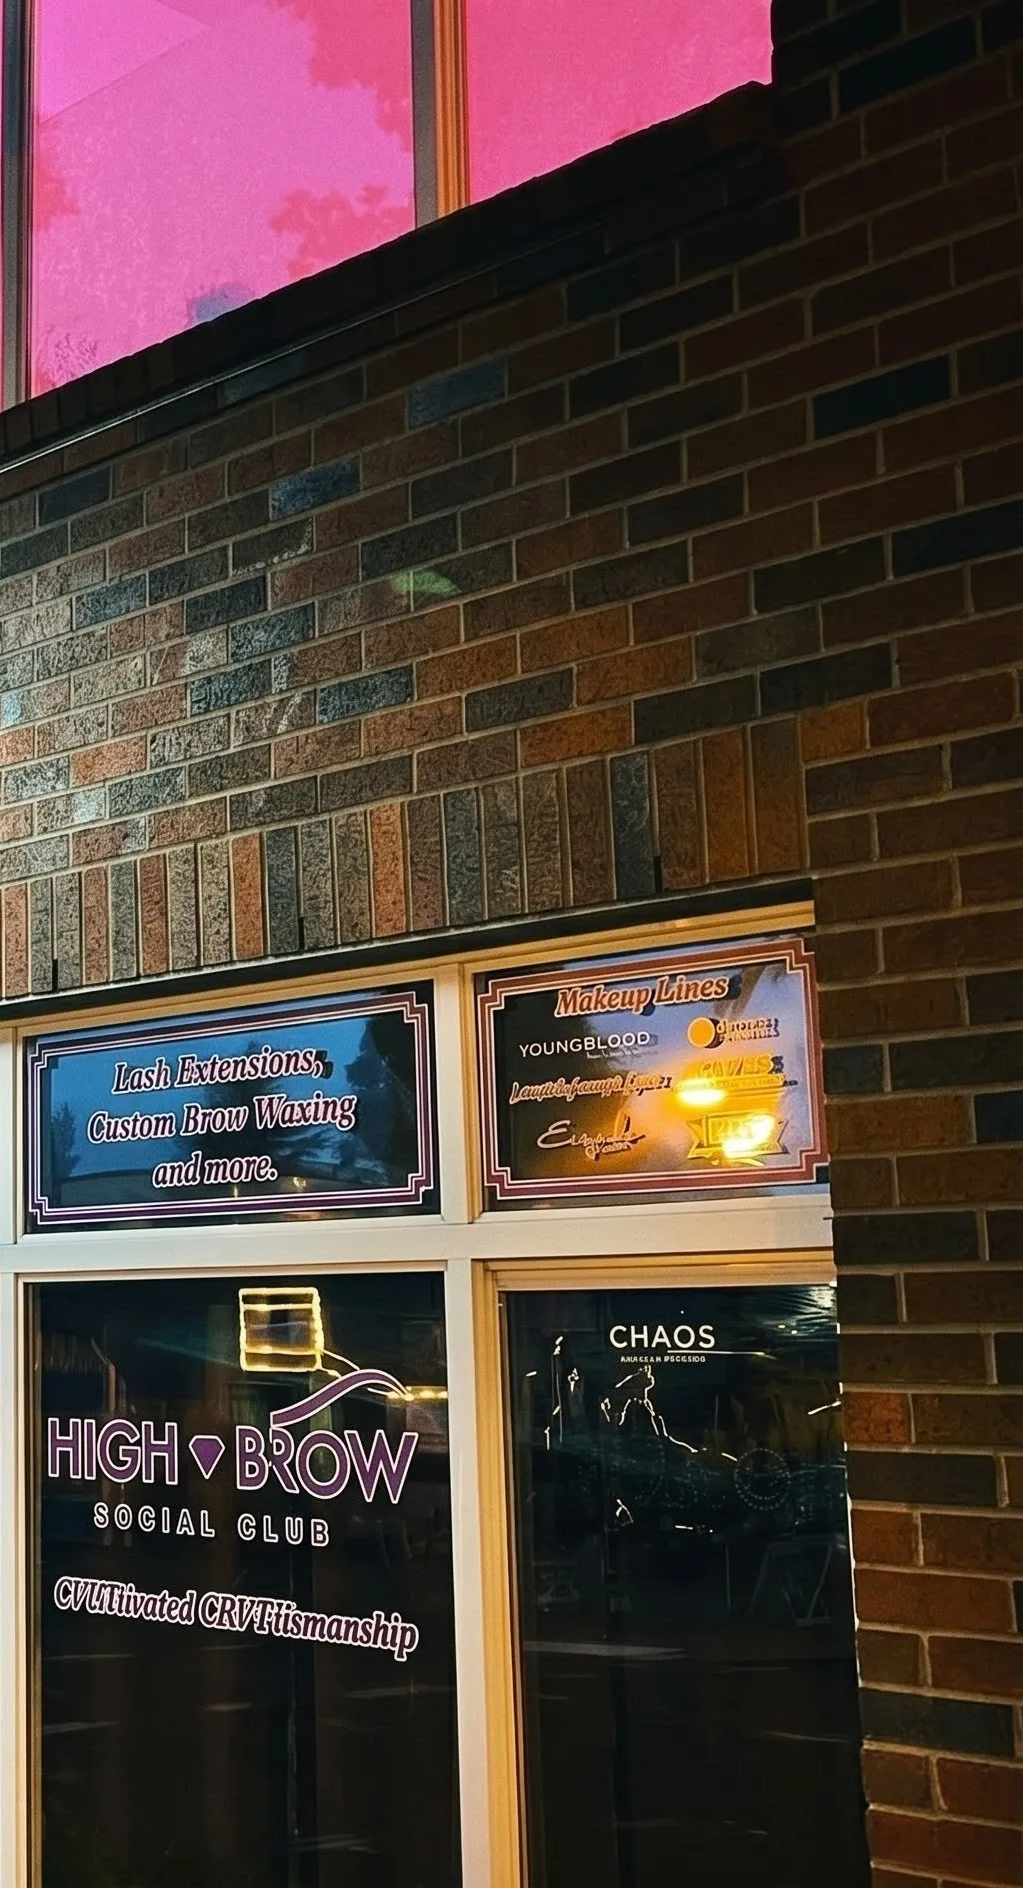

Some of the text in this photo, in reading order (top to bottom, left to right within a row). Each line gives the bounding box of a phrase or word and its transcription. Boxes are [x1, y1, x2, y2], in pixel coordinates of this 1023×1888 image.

[554, 976, 730, 1018] Makeup Lines
[518, 1031, 651, 1058] YOUNGBLOOD
[111, 1045, 324, 1095] Lash Extensions,
[87, 1092, 358, 1143] Custom Brow Waxing
[152, 1151, 278, 1188] and more.
[609, 1324, 717, 1350] CHAOS
[47, 1417, 178, 1485] HIGH
[235, 1412, 420, 1504] BROW
[93, 1502, 331, 1547] SOCIAL CLUB
